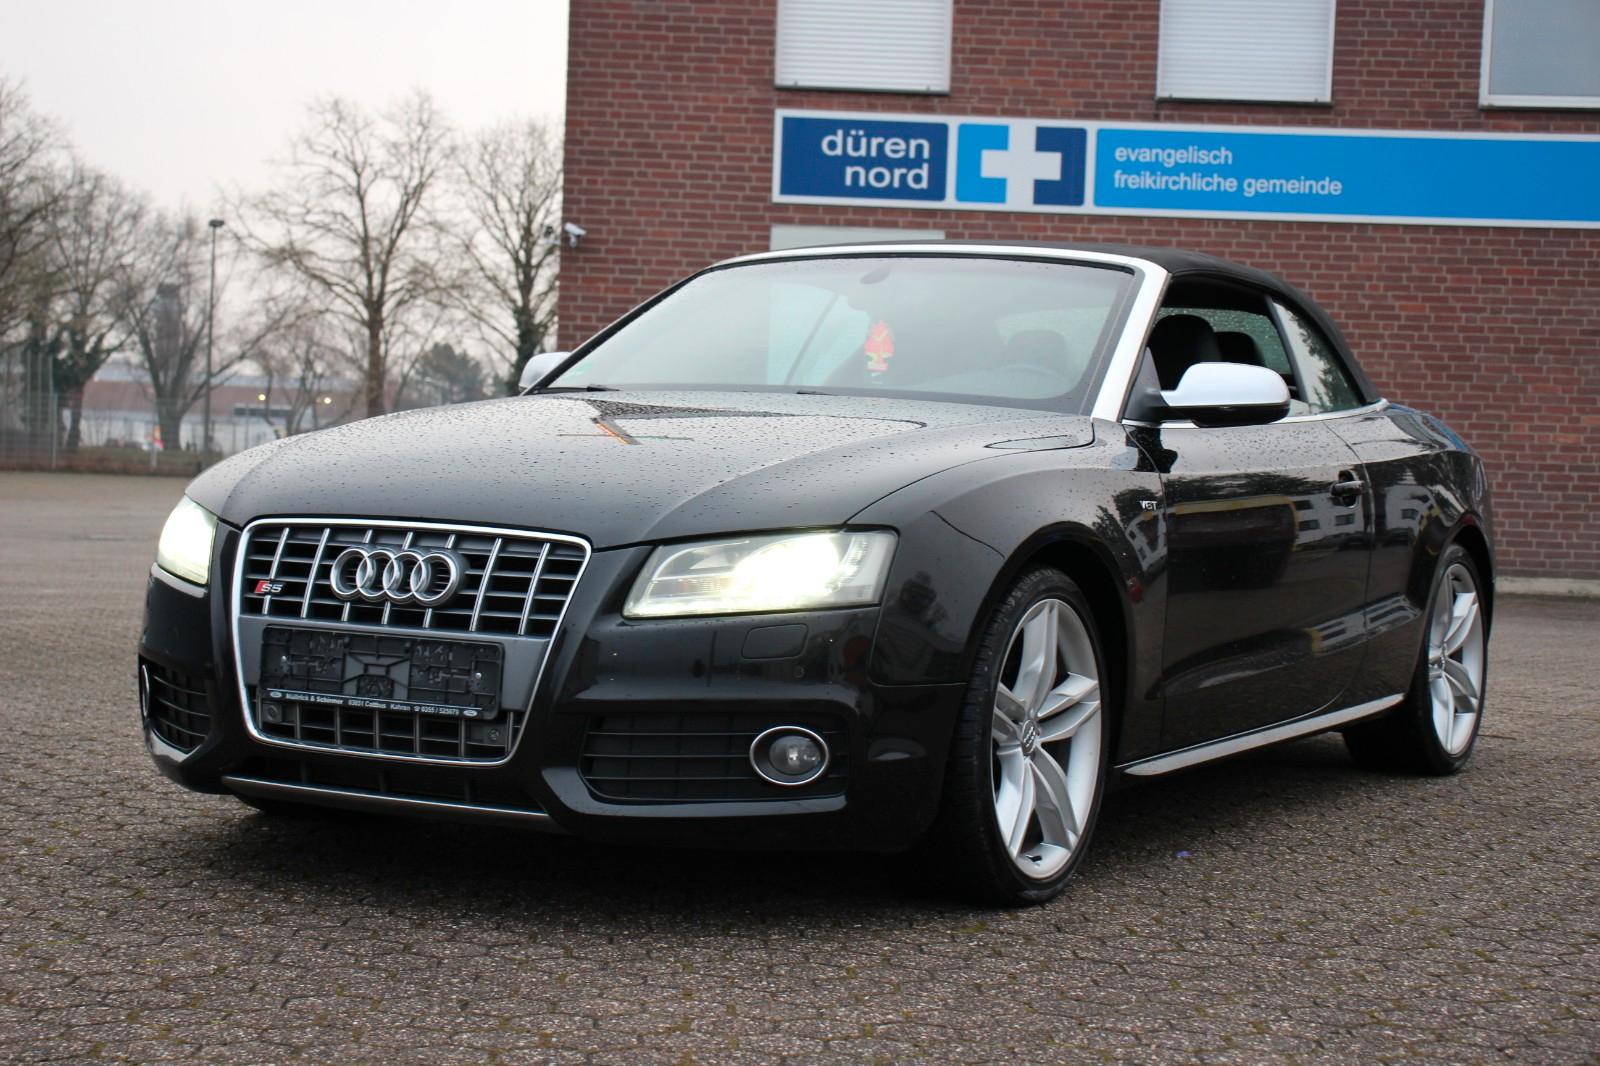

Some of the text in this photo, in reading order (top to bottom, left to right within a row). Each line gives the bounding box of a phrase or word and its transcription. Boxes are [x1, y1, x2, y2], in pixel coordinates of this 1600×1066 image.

[820, 128, 930, 160] düren
[1114, 145, 1233, 168] evangelisch
[844, 162, 929, 190] nord
[1113, 169, 1343, 197] freikirchliche gemeinde
[261, 583, 283, 593] S5
